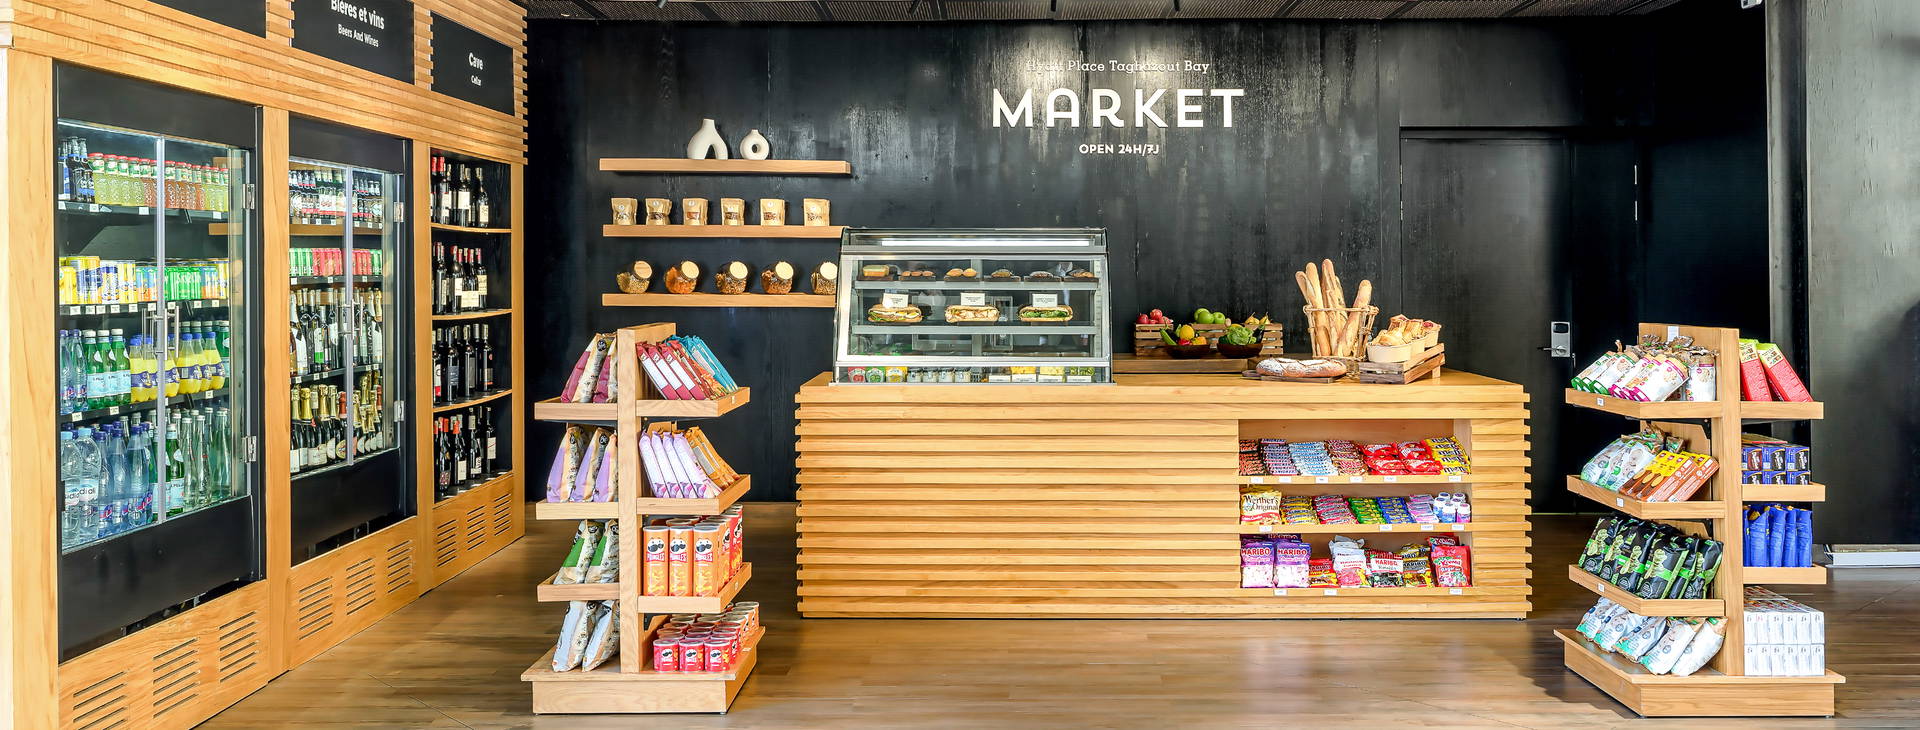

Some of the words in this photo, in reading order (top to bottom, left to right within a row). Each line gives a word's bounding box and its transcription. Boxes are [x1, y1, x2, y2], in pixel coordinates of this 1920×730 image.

[358, 7, 368, 23] et
[368, 10, 385, 30] vins
[338, 23, 353, 38] Beers
[353, 29, 364, 42] And
[364, 32, 379, 48] Wines
[468, 52, 484, 71] Cave
[1026, 60, 1063, 75] Hyatt
[1068, 60, 1105, 72] Place
[1109, 59, 1180, 75] Taghazout
[1184, 60, 1210, 75] Bay
[470, 75, 482, 87] Cellar
[992, 88, 1245, 128] MARKET
[1078, 144, 1114, 155] OPEN
[1117, 143, 1160, 157] 24H/7J
[1243, 495, 1279, 505] Werther's
[1252, 502, 1279, 512] Original
[1241, 548, 1271, 556] HARIBO
